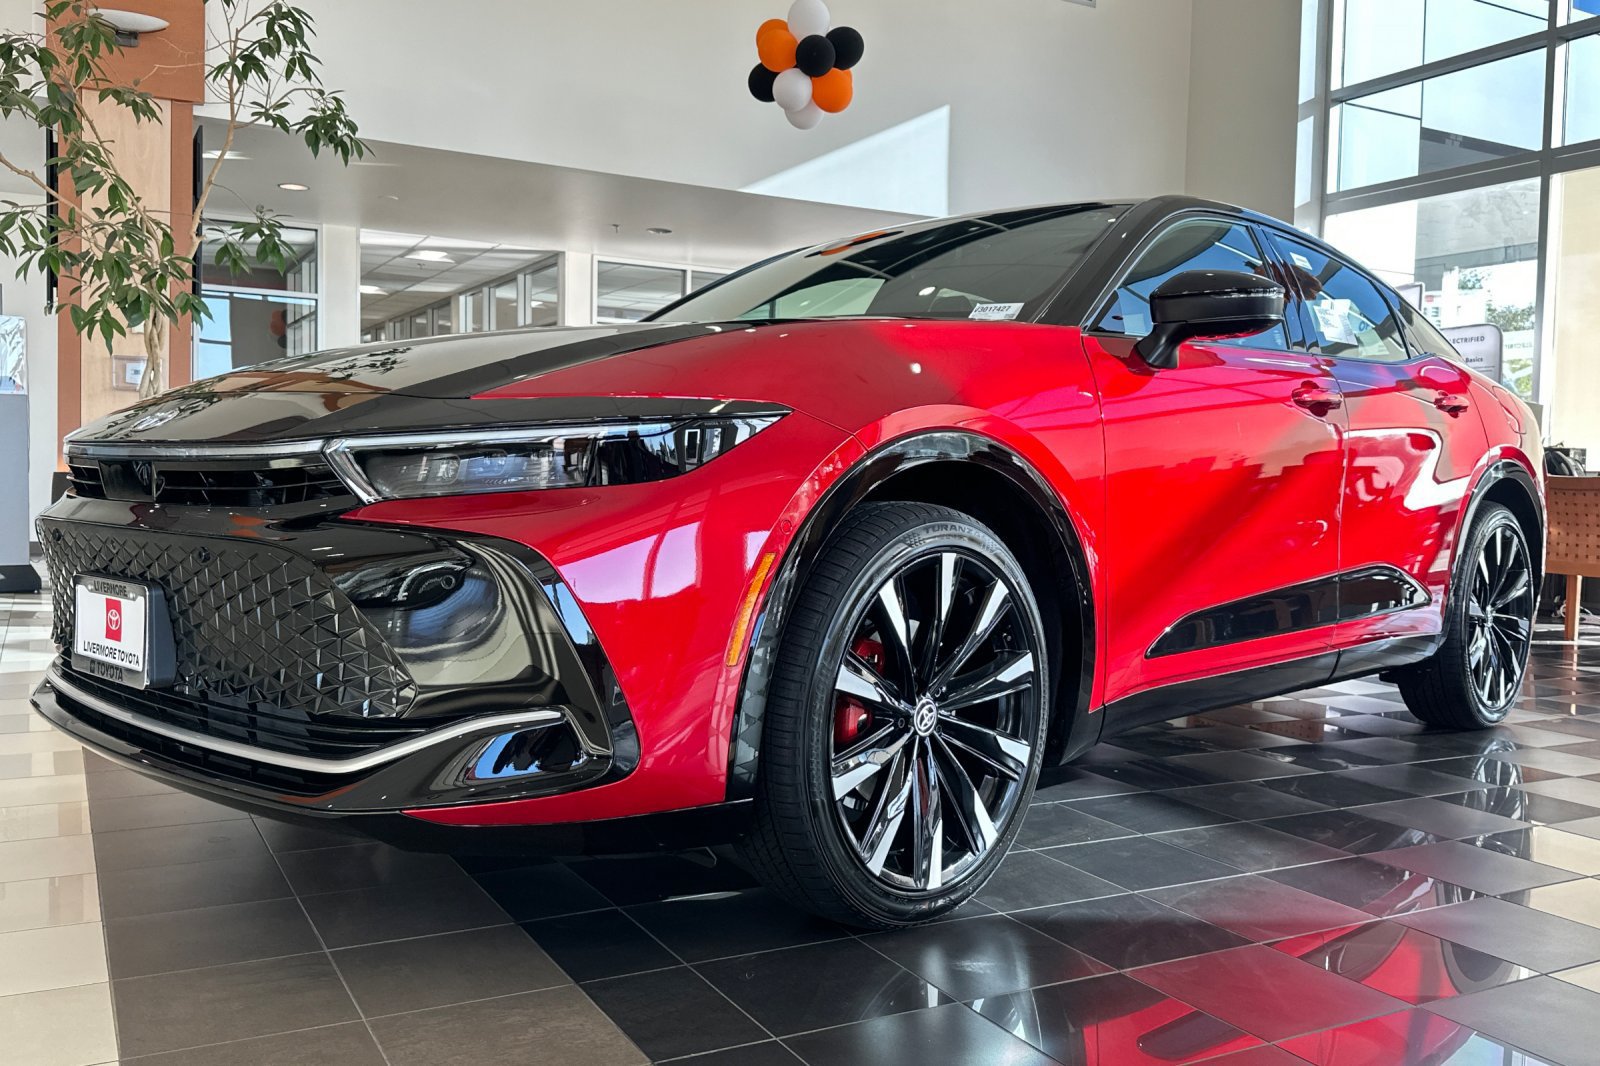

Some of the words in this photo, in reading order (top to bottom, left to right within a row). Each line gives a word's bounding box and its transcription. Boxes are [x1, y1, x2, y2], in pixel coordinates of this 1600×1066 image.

[93, 580, 128, 598] LIVERMORE
[84, 641, 117, 659] LIVERMORE
[118, 649, 140, 667] TOYOTA
[97, 661, 123, 681] TOYOTA
